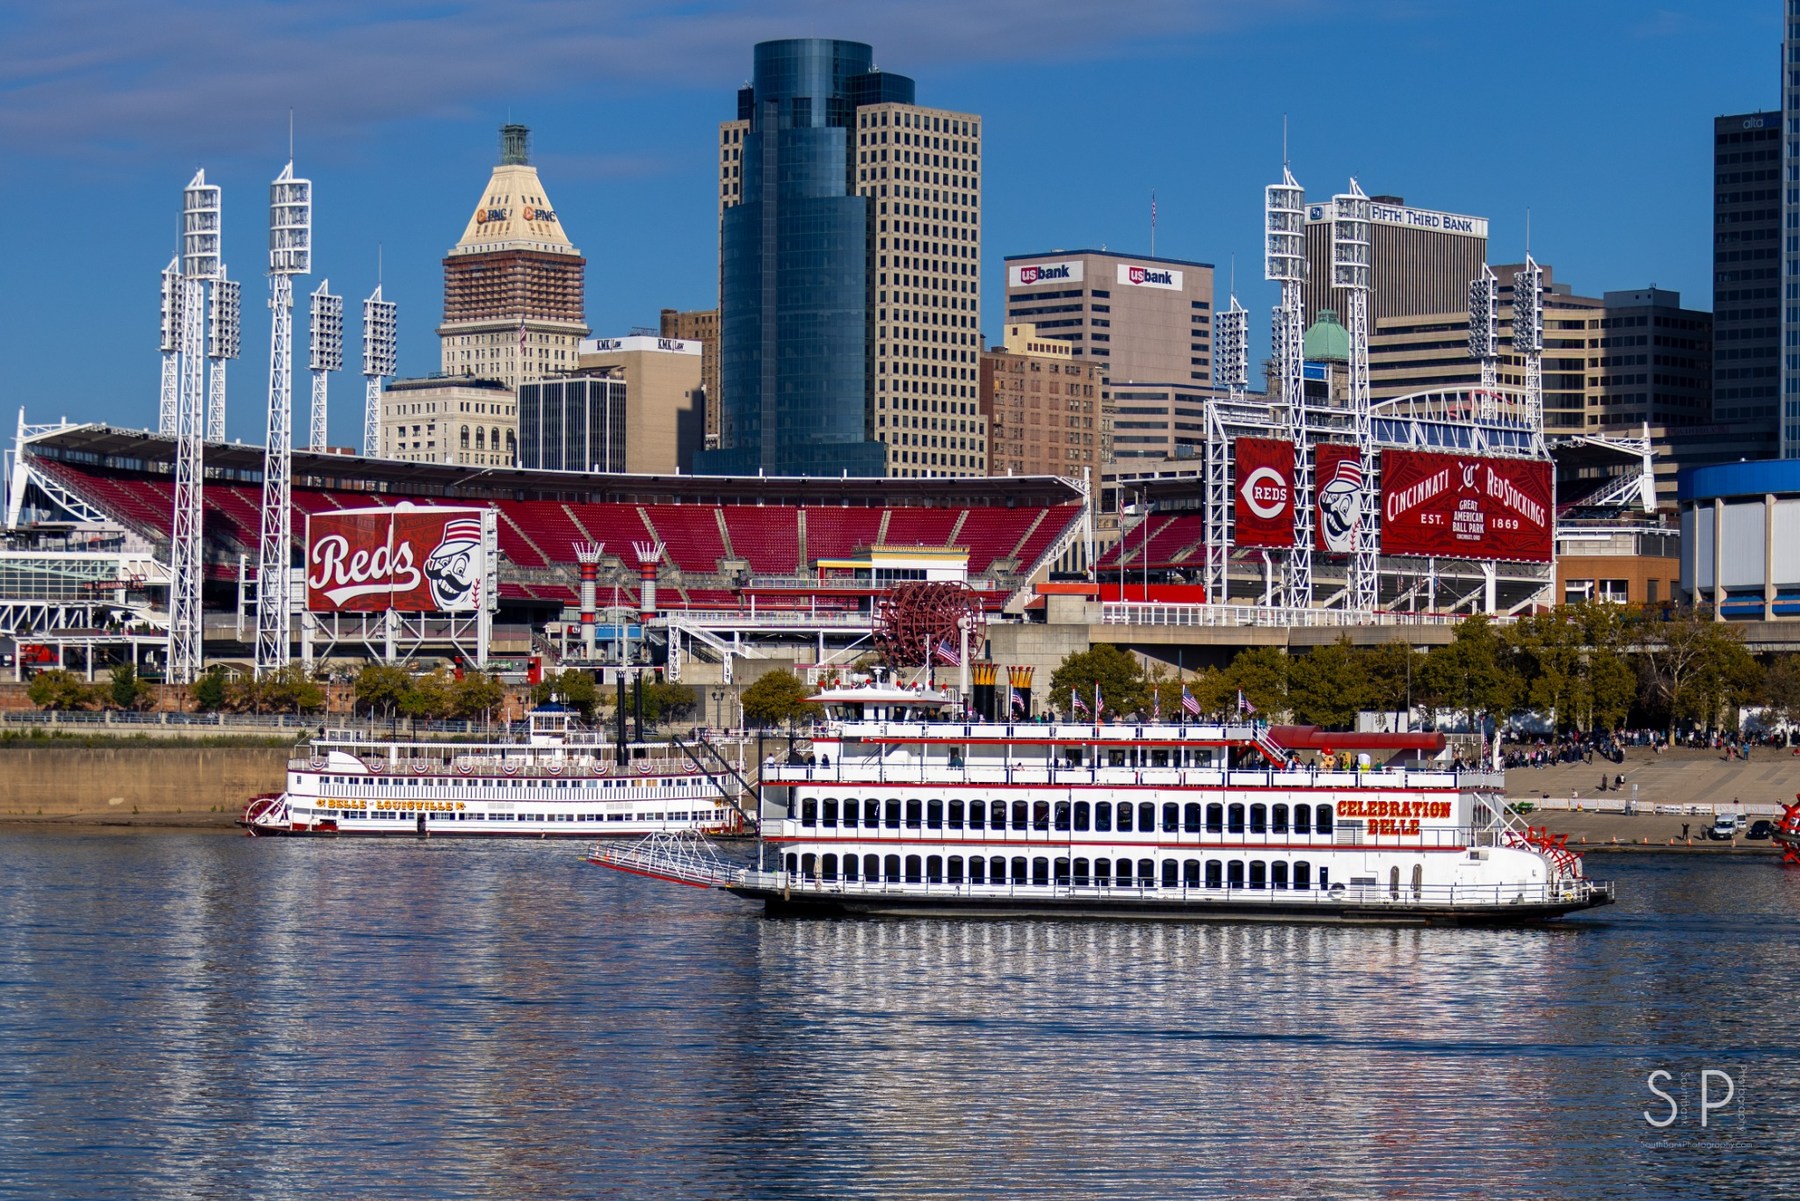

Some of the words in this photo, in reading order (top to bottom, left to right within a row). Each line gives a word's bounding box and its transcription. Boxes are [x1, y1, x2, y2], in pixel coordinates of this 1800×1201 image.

[488, 208, 507, 222] PNC
[535, 209, 556, 222] PNC
[1372, 207, 1402, 222] FIFTH
[1406, 210, 1440, 228] THIRD
[1443, 216, 1473, 233] BANK
[597, 340, 610, 351] KMK
[658, 339, 672, 350] KMK
[1254, 486, 1287, 501] REDS
[1387, 468, 1449, 522] CINCINNATI
[1459, 500, 1478, 511] GREAT
[1420, 513, 1444, 525] EST.
[1453, 511, 1484, 523] AMERICAN
[1452, 521, 1467, 533] BALL
[1468, 522, 1485, 534] PARK
[1492, 518, 1519, 530] 1869
[309, 523, 421, 594] Reds
[328, 799, 367, 810] BELLE
[376, 799, 454, 811] LOUISVILLE
[1336, 800, 1451, 818] CELEBRATION
[1367, 818, 1420, 836] BELLE
